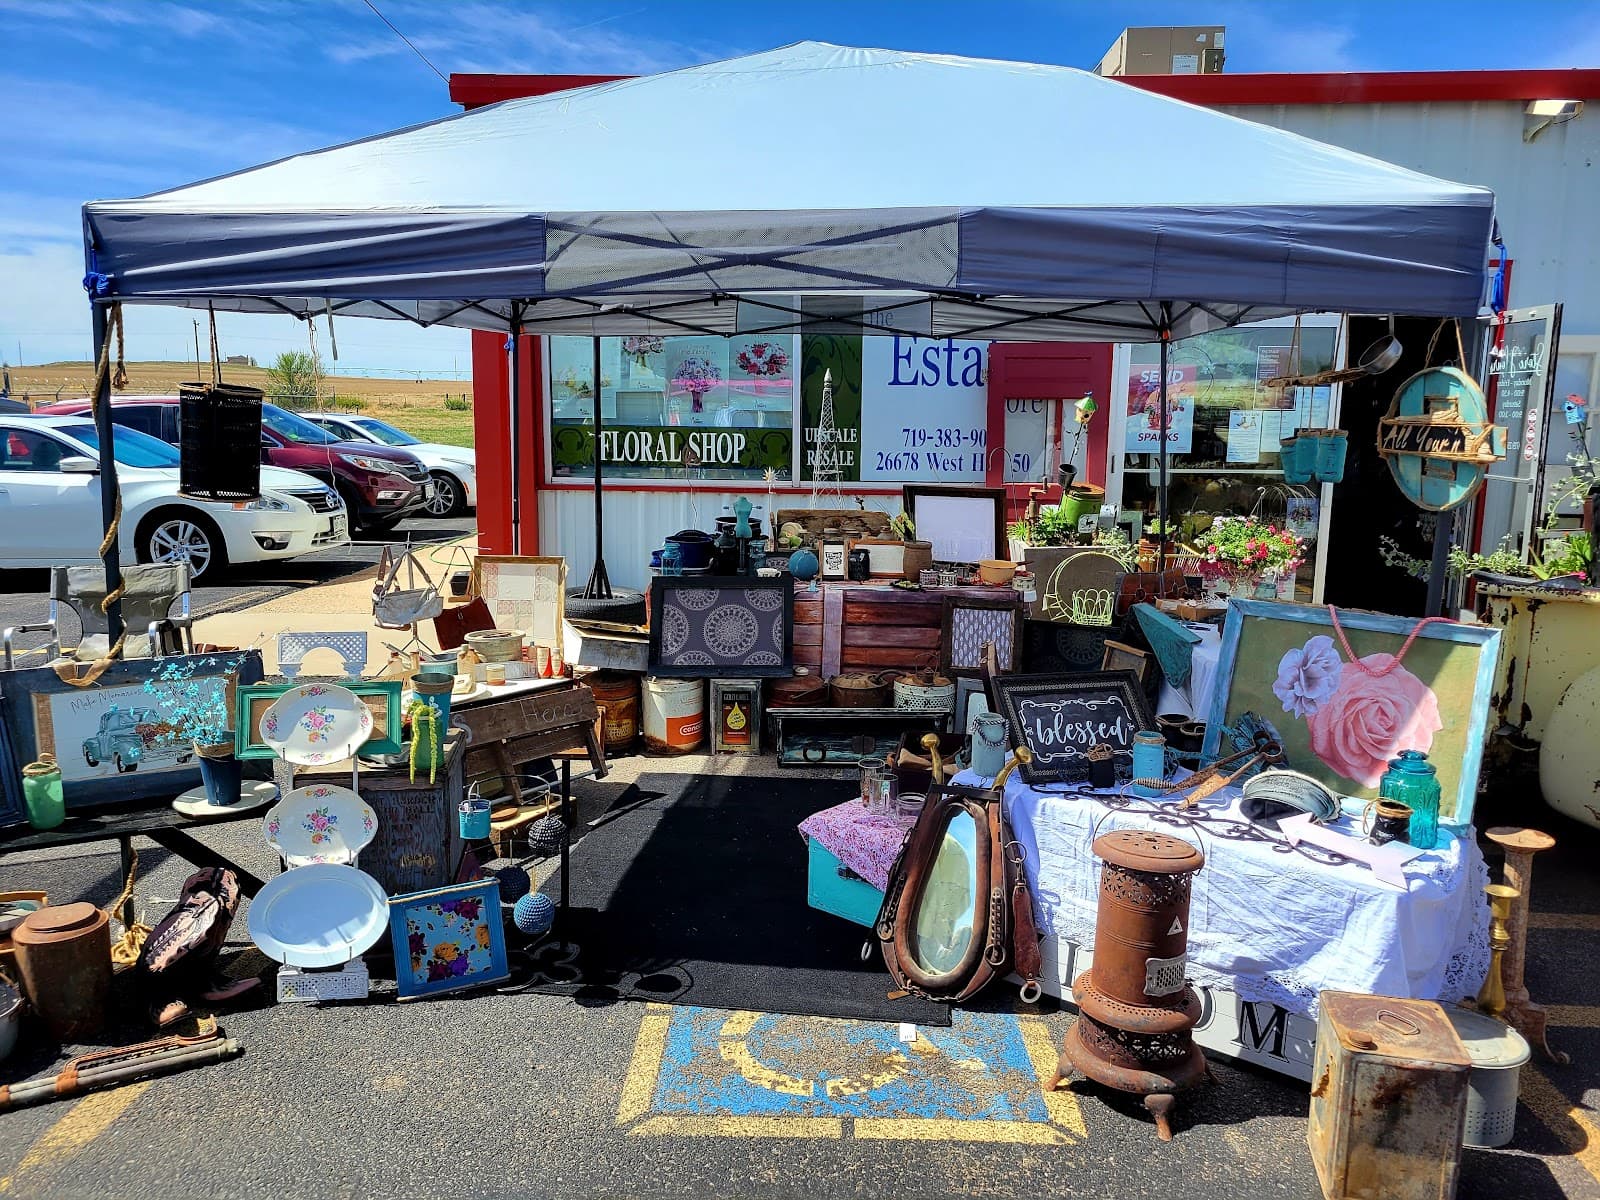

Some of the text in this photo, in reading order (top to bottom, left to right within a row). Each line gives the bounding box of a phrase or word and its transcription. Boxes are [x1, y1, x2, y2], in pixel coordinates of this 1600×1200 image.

[888, 332, 986, 388] Esta
[1007, 398, 1043, 414] ore
[804, 427, 858, 443] UPSCALE
[902, 428, 987, 448] 719-383-90
[1383, 424, 1412, 450] All
[601, 431, 746, 464] FLORAL SHOP
[806, 449, 855, 466] RESALE
[876, 451, 1030, 472] 26678 West H 50
[1036, 712, 1128, 747] blessed
